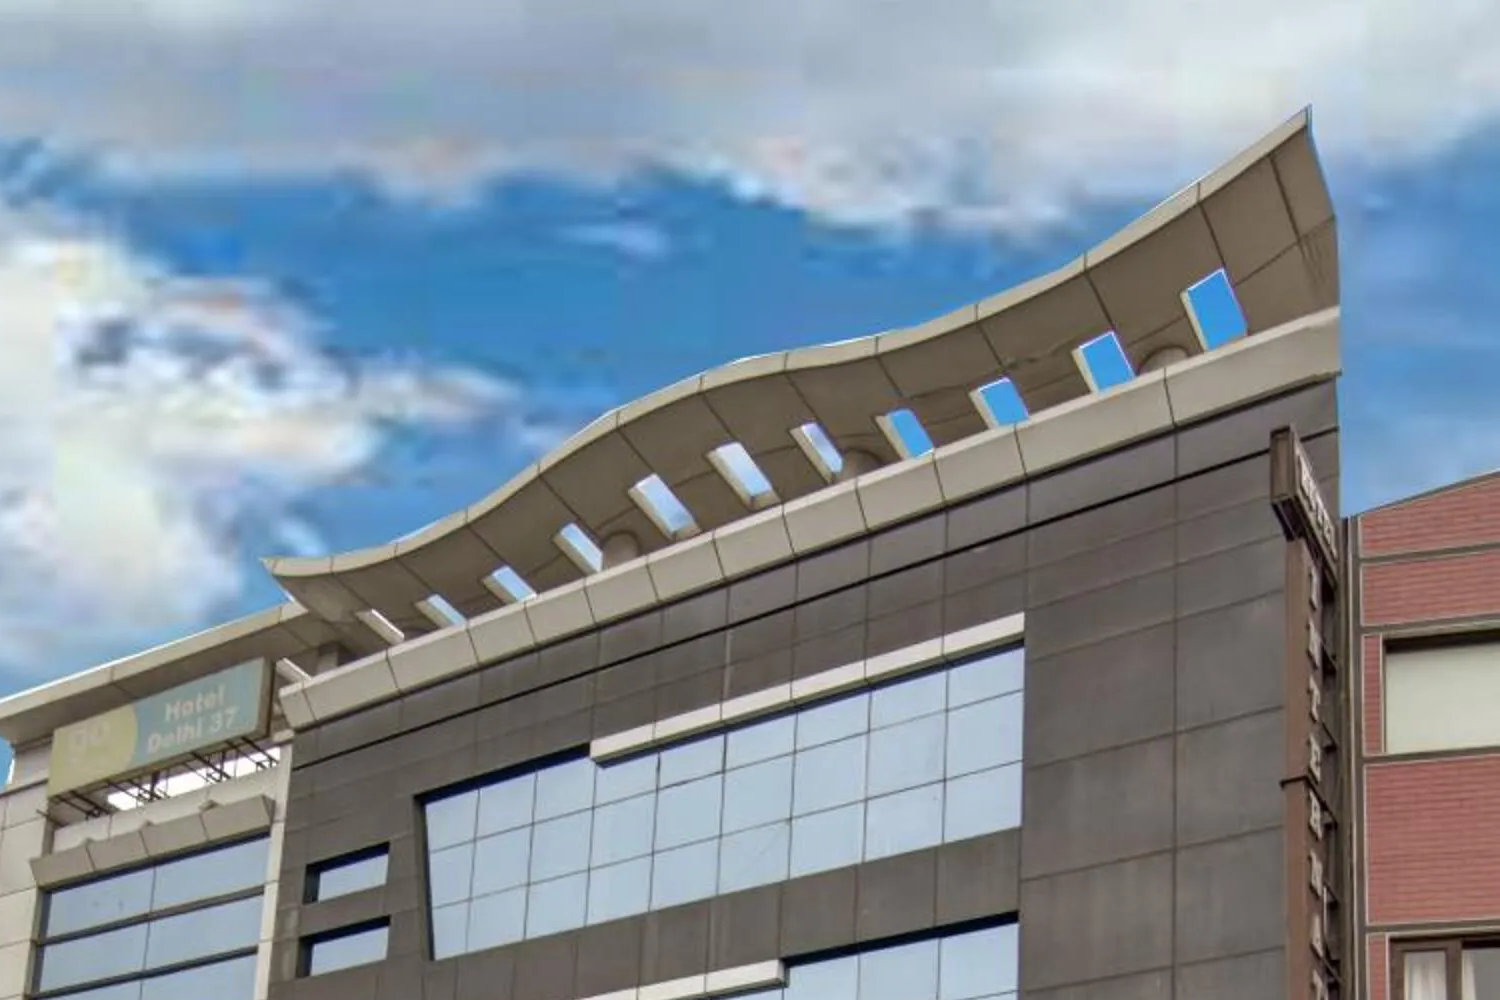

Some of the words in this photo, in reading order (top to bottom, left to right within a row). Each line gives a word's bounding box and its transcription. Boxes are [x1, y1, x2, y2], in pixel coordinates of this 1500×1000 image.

[164, 685, 226, 723] Hotel
[146, 719, 203, 754] Delhi
[210, 704, 240, 735] 37
